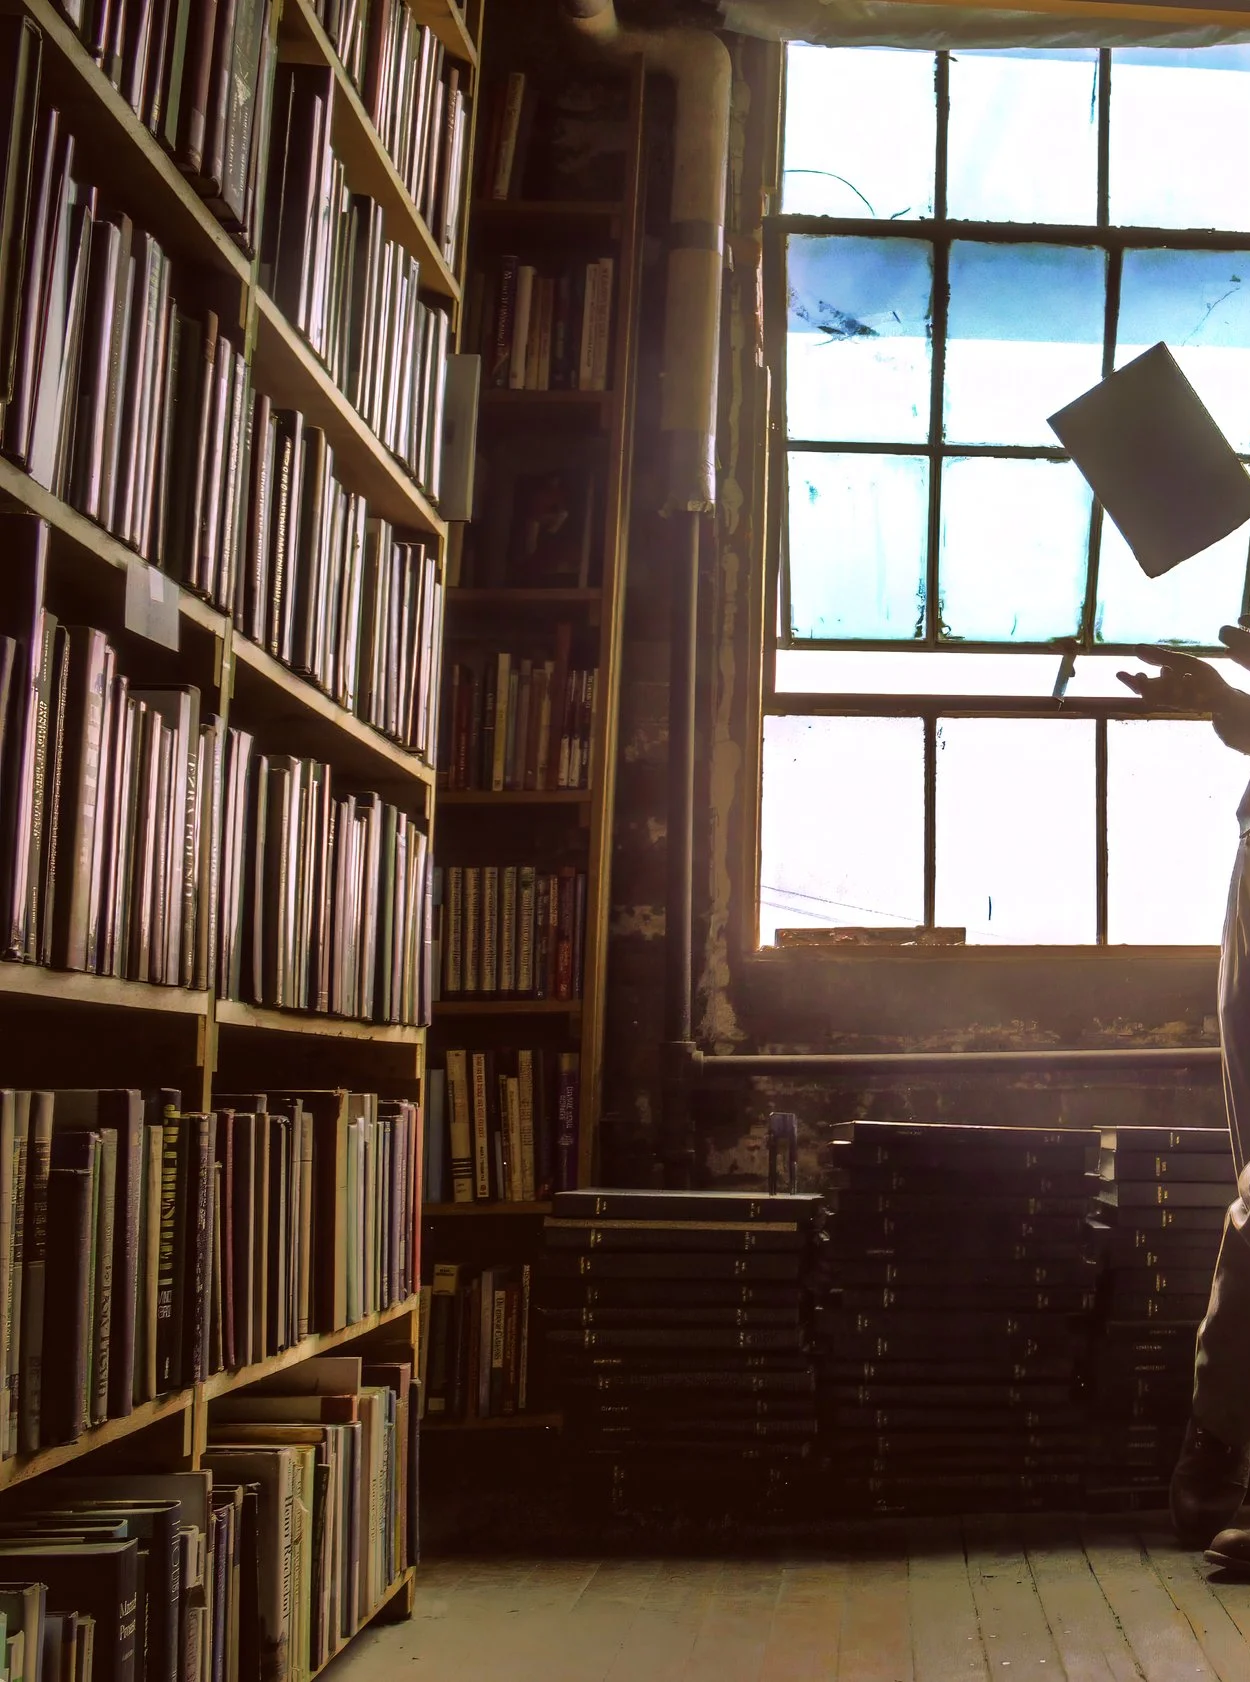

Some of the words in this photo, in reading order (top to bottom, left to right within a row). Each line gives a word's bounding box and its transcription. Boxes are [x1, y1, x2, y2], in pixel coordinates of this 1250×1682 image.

[186, 762, 197, 813] EZRA
[184, 823, 194, 898] POUND
[283, 1496, 294, 1540] Henri
[282, 1544, 293, 1620] Rochefort
